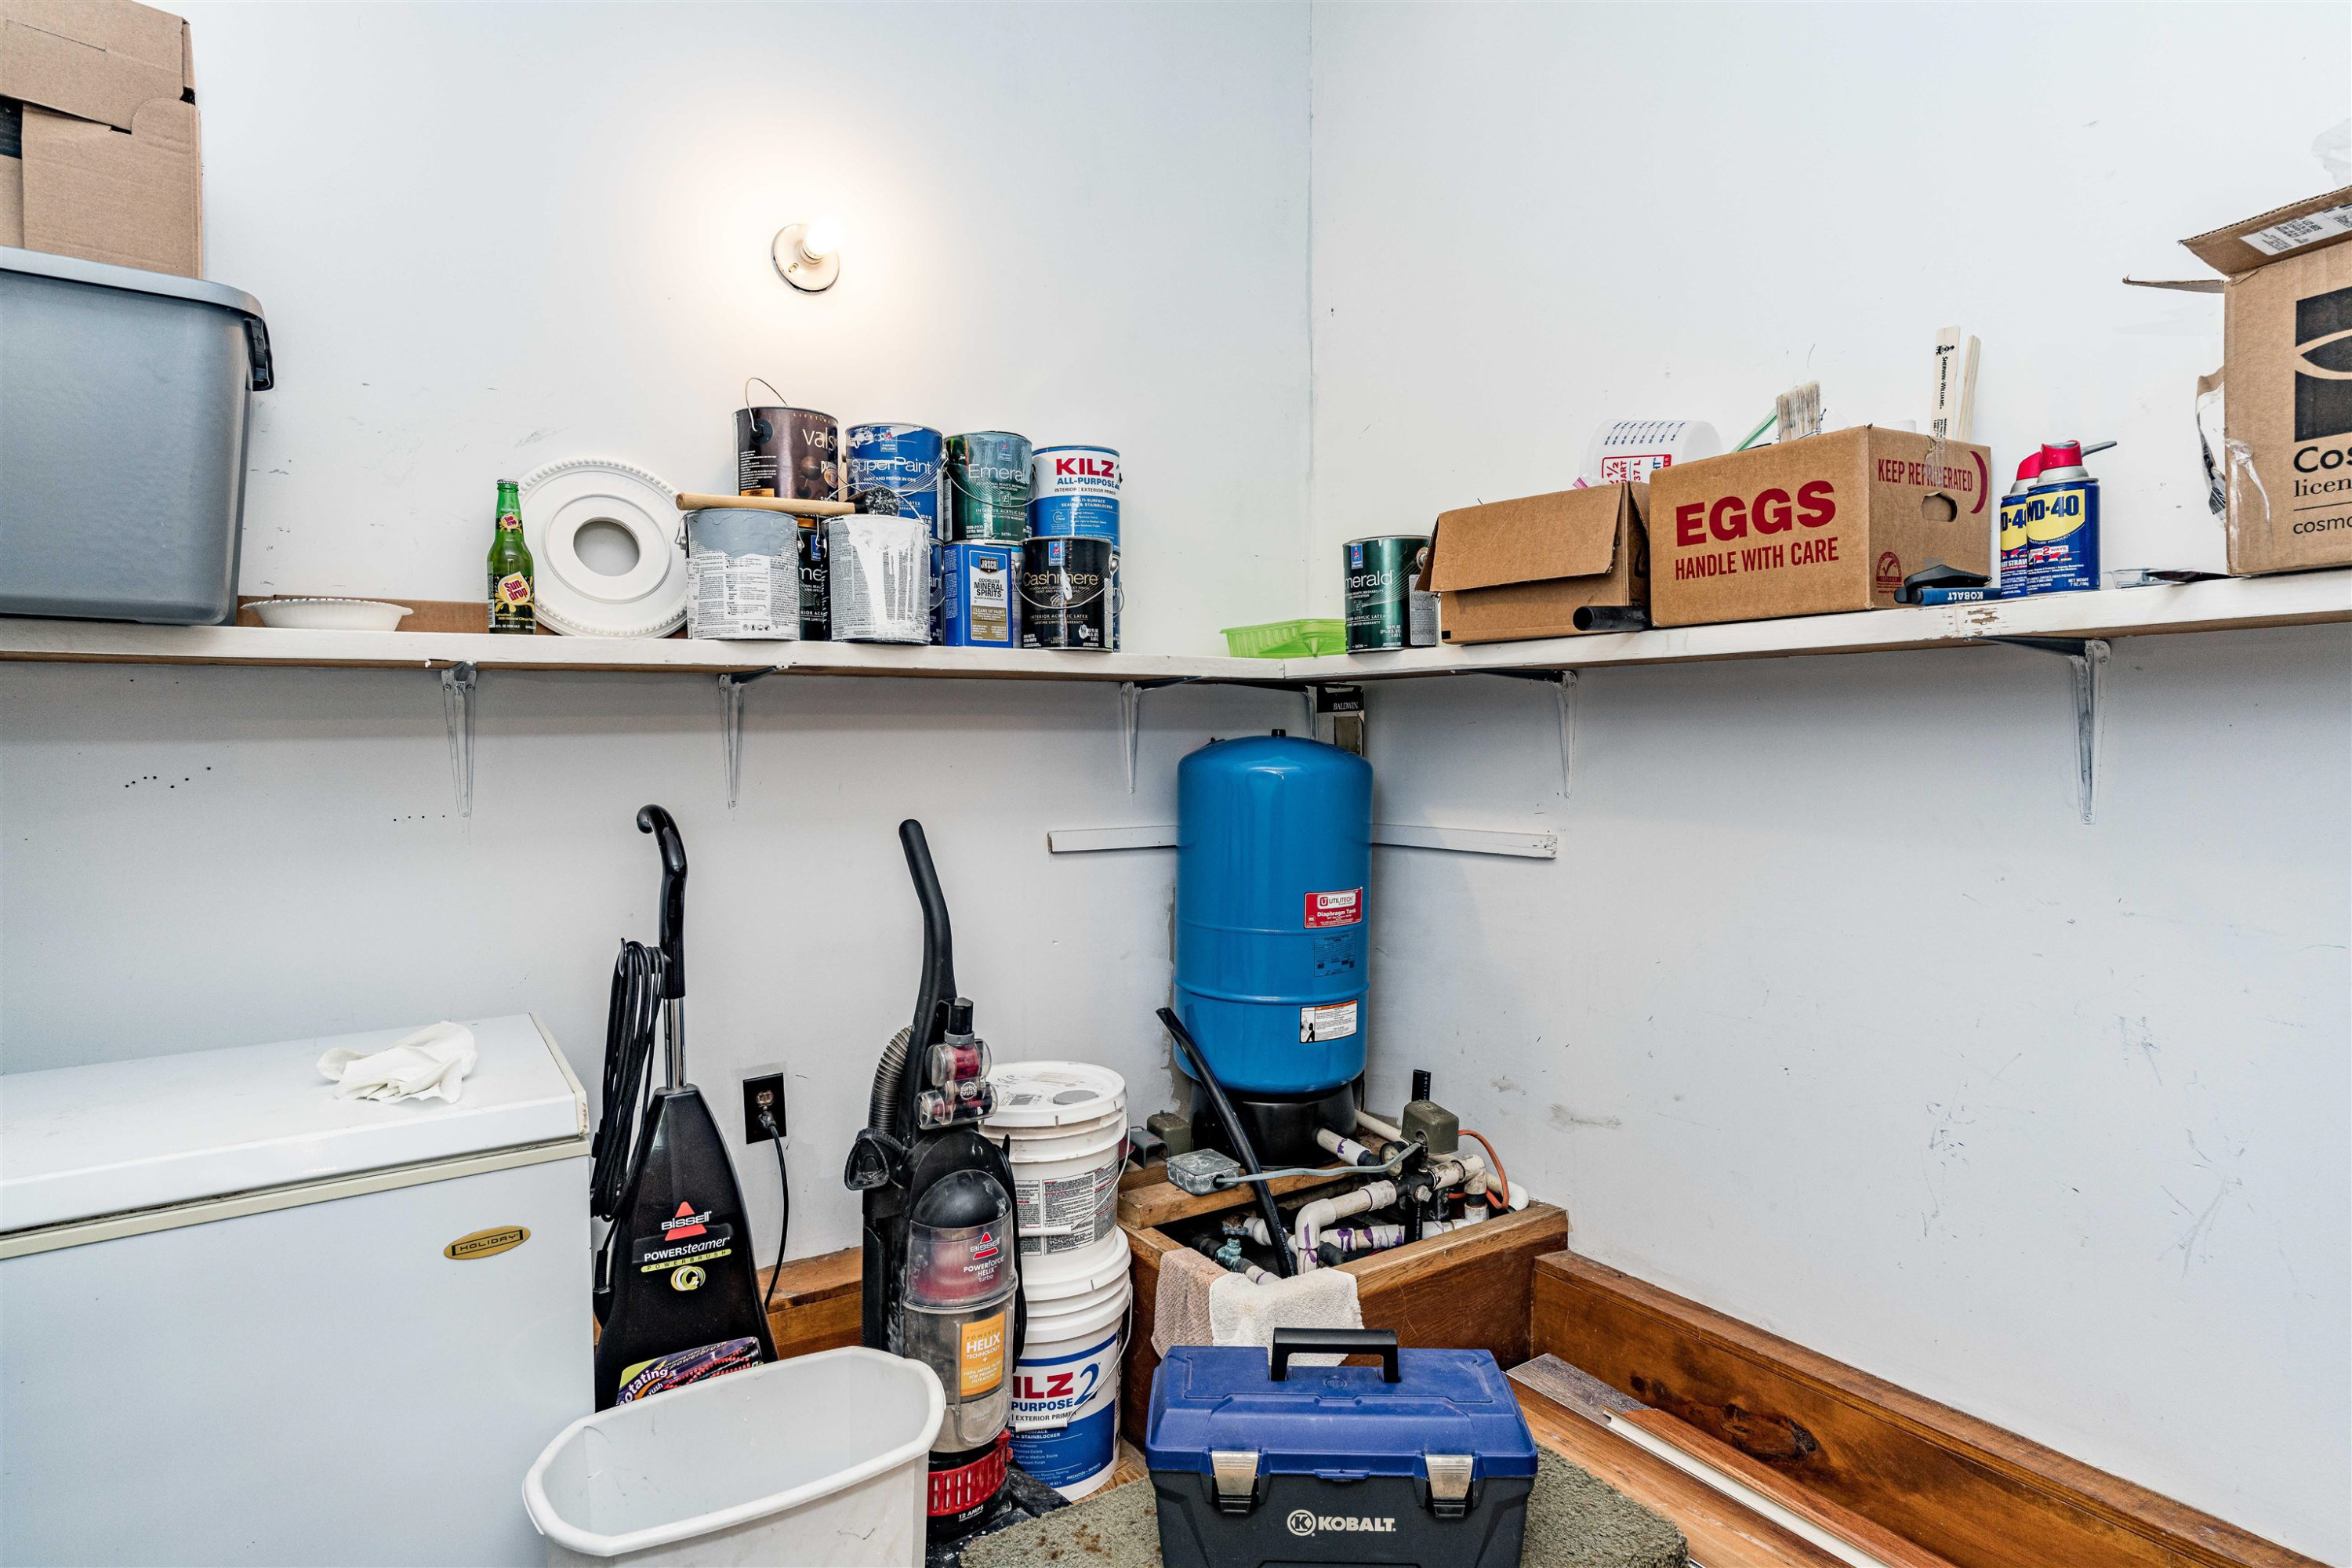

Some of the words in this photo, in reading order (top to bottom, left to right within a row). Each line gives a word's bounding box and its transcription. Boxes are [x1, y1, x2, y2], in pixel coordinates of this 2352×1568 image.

[851, 456, 932, 475] SuperPaint
[1055, 458, 1115, 479] KILZ
[1878, 458, 1905, 484] KEEP
[1057, 477, 1115, 488] ALL-PURPOSE
[2293, 477, 2352, 498] licen
[1676, 480, 1836, 547] EGGS
[2027, 495, 2080, 523] WD-40
[2042, 546, 2050, 555] 2
[980, 559, 997, 571] JASCO
[1675, 551, 1737, 581] HANDLE
[1741, 544, 1784, 572] WITH
[1791, 536, 1839, 566] CARE
[974, 582, 1004, 591] MINERAL
[976, 589, 1002, 598] SPIRITS
[1947, 590, 1984, 601] KOBALT
[1333, 702, 1359, 710] BALDWIN
[1328, 895, 1353, 904] UTILITECH
[960, 1083, 978, 1092] turbo
[459, 1233, 517, 1252] HOLIDAY
[644, 1236, 731, 1263] POWERsteamer
[646, 1249, 727, 1272] POWERBRUSH
[963, 1254, 1005, 1273] POWERforce
[978, 1267, 995, 1277] HELIX
[978, 1274, 994, 1283] turbo
[966, 1331, 1001, 1354] HELIX
[967, 1345, 1000, 1360] TECHNOLOGY
[1011, 1397, 1073, 1413] PURPOSE
[1051, 1410, 1077, 1421] PRIMER
[967, 1504, 985, 1517] AMPS
[1318, 1516, 1397, 1533] KOBALT
